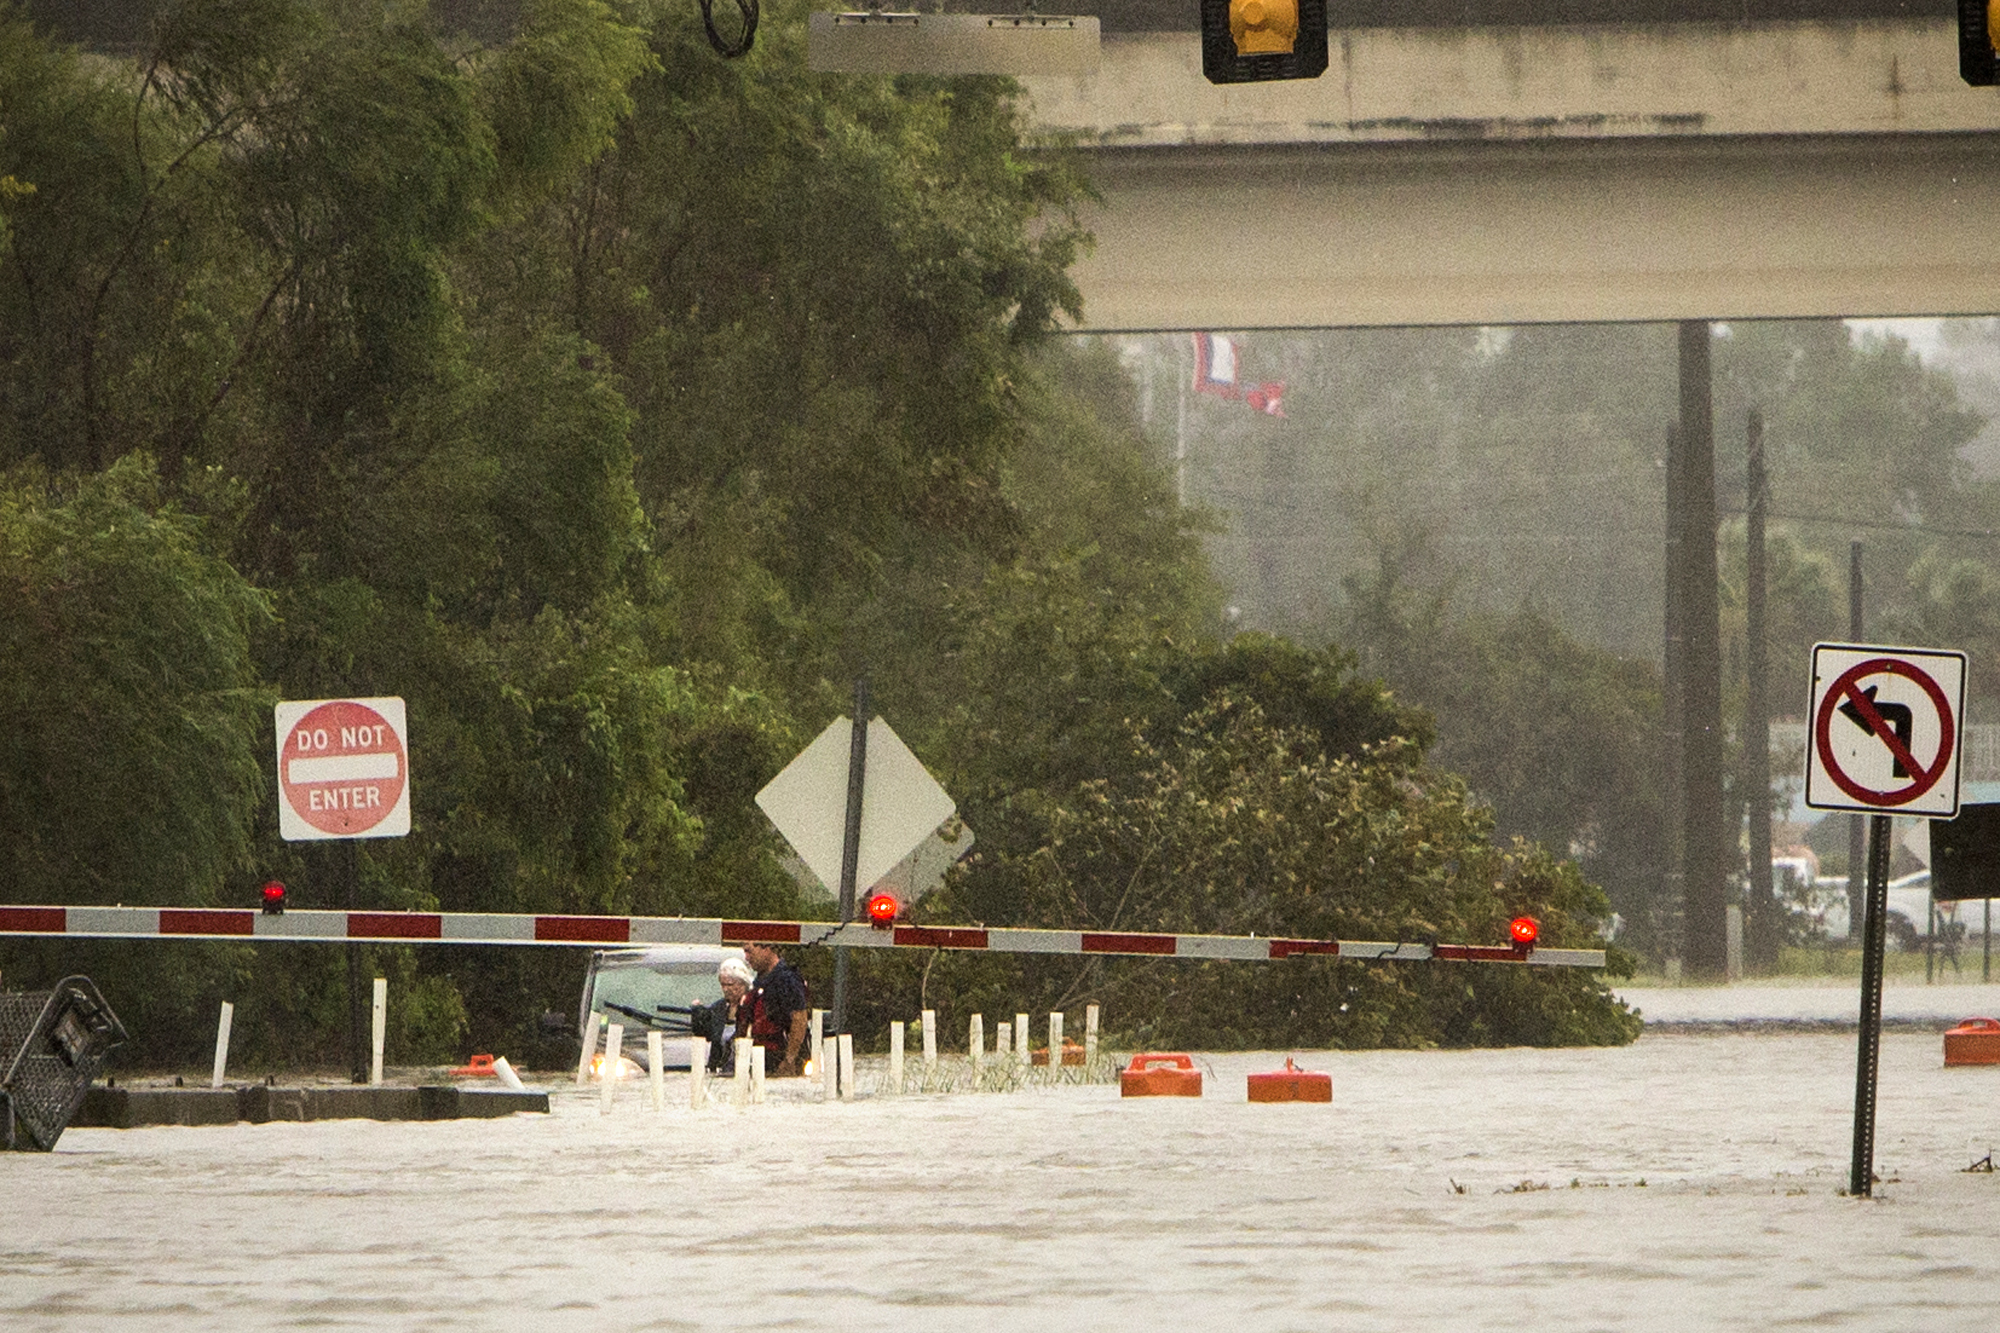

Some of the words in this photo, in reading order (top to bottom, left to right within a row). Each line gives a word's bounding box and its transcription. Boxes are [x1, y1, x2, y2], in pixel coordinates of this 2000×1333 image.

[298, 729, 328, 751] DO
[341, 725, 385, 748] NOT
[309, 786, 380, 811] ENTER
